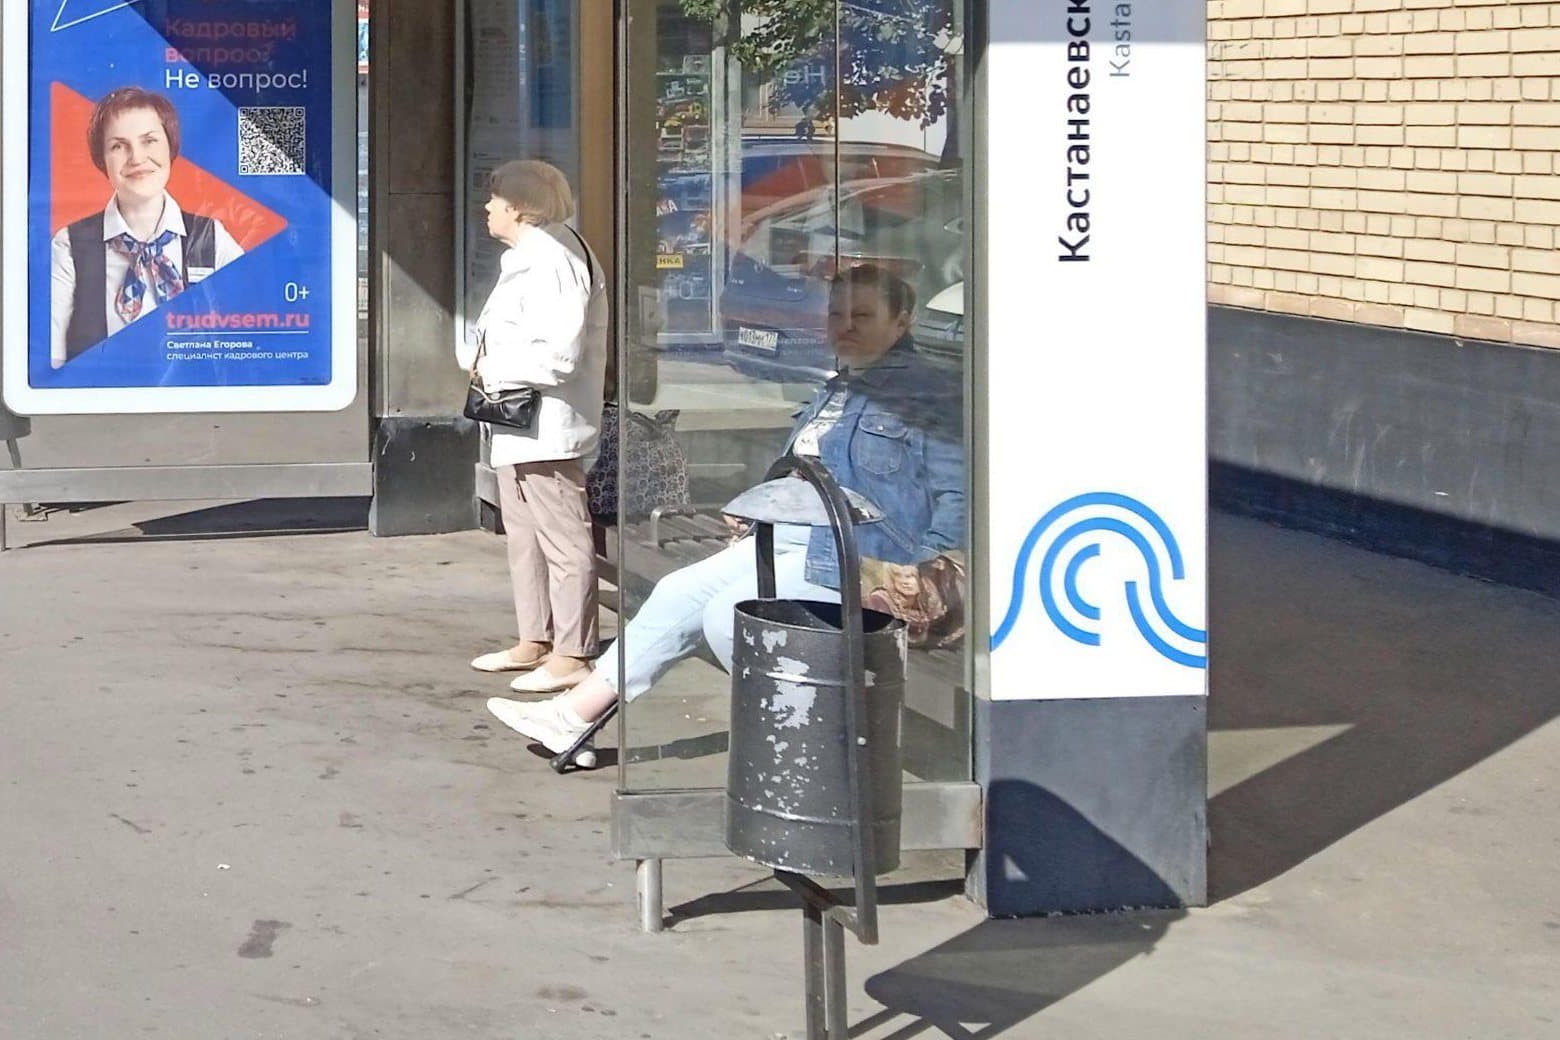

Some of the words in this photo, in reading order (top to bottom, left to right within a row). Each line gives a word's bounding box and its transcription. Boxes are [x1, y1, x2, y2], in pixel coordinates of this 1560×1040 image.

[165, 18, 297, 40] Кадровый
[165, 69, 200, 89] Не
[208, 69, 308, 92] вопрос!
[284, 282, 310, 302] 0+
[166, 310, 310, 329] trudvsem.ru
[166, 340, 212, 349] Светлана
[213, 340, 254, 350] Егорова
[166, 351, 223, 360] специалист
[224, 351, 273, 360] кадрового
[275, 351, 309, 360] центра
